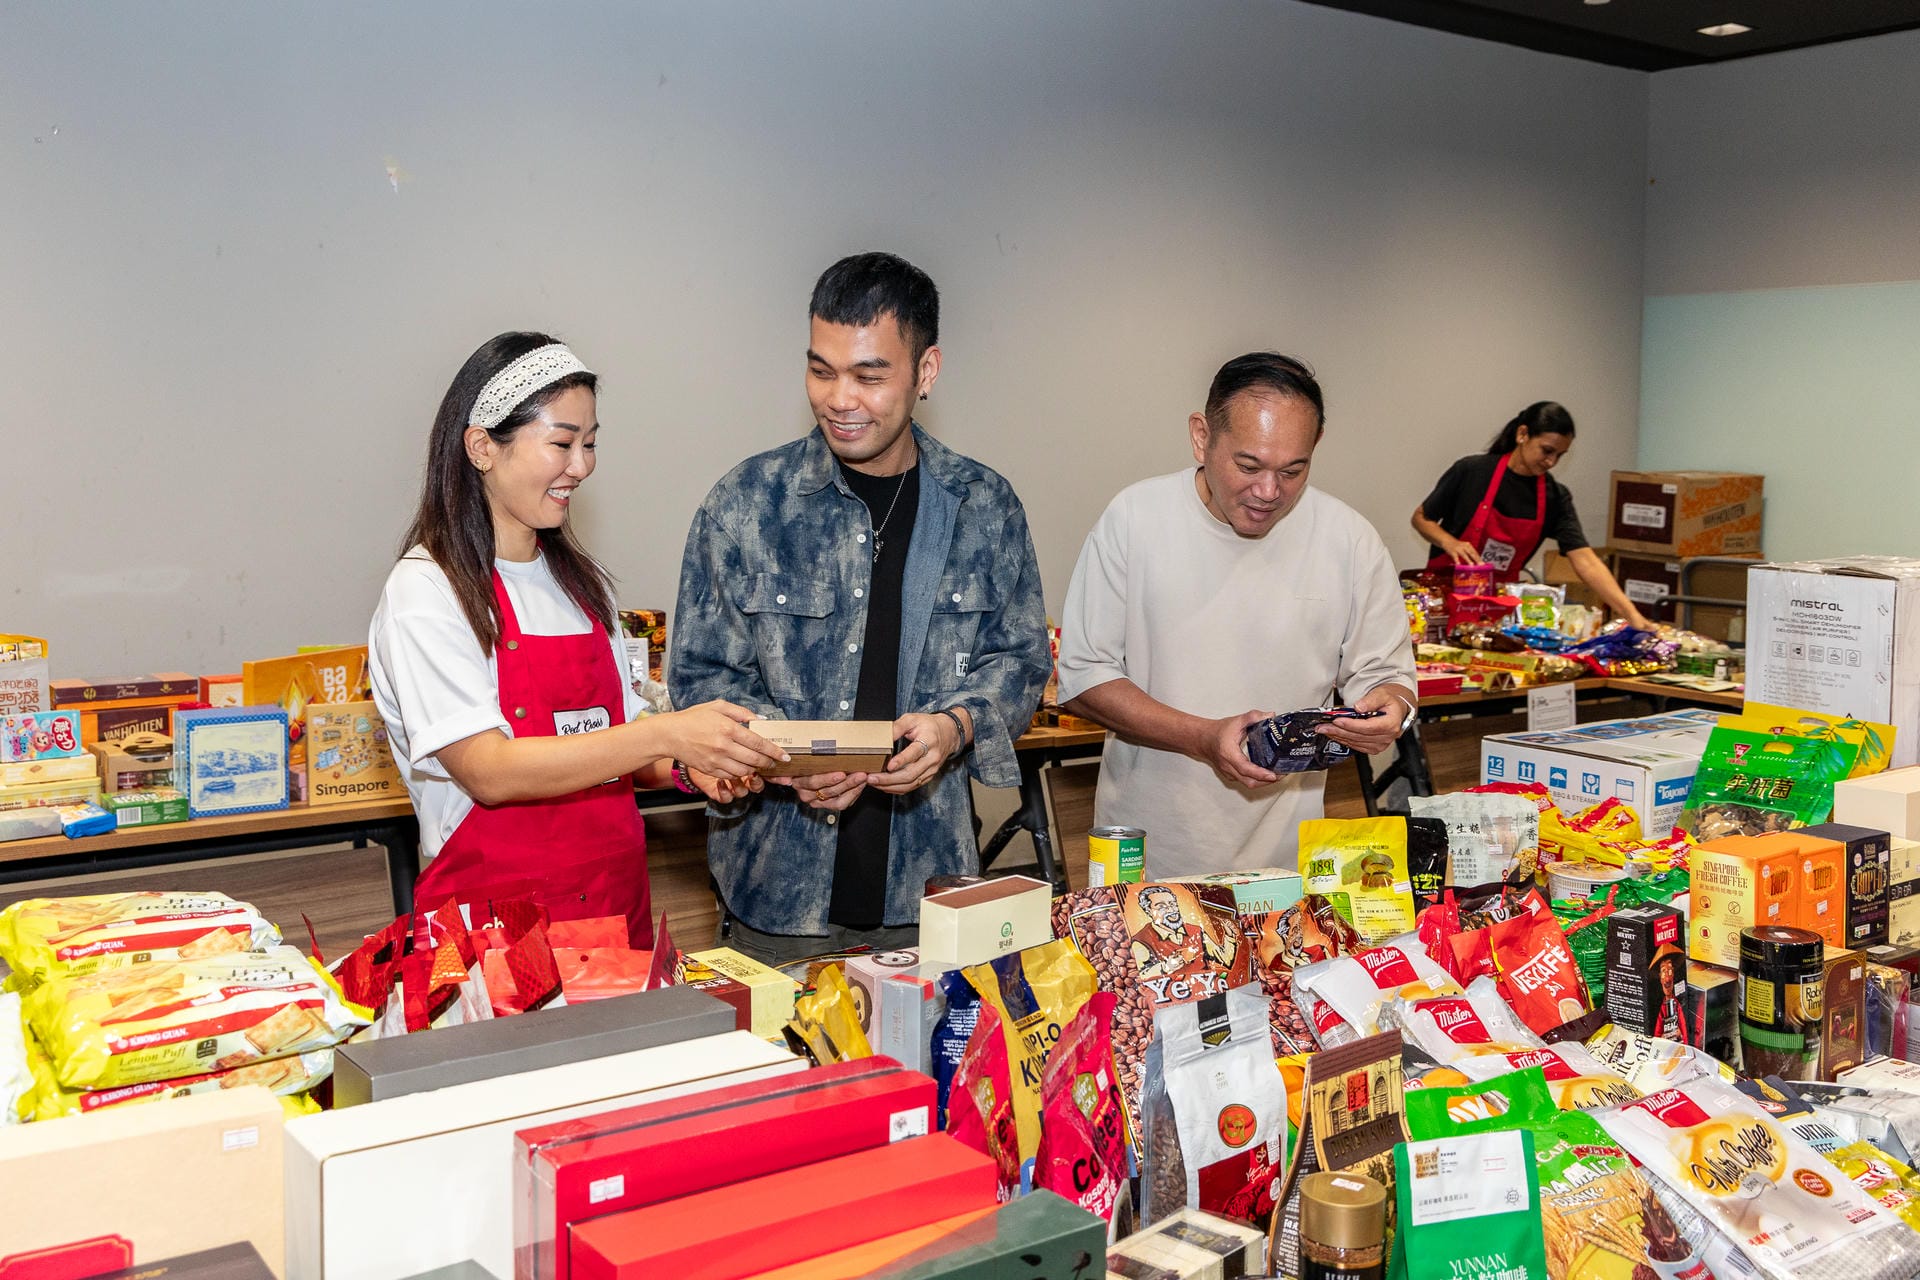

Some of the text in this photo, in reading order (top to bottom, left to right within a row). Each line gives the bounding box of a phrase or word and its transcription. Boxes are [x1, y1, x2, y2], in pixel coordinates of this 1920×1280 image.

[1790, 599, 1844, 612] mistral
[104, 728, 122, 742] VAN
[121, 717, 164, 741] HOUTEN
[562, 722, 581, 735] Red
[1489, 758, 1503, 769] 12
[315, 780, 390, 796] Singapore
[1726, 773, 1796, 800] 牛肝菌
[1312, 859, 1335, 874] 1891
[1703, 861, 1741, 876] SINGAPORE
[1696, 869, 1748, 889] FRESH COFFEE
[1238, 899, 1274, 913] RIAN
[138, 954, 149, 962] 12
[1360, 948, 1401, 969] Mister
[1436, 1005, 1473, 1028] Mister
[129, 1032, 162, 1047] KHONG
[203, 1039, 213, 1048] 12
[119, 1045, 189, 1067] Lemon Puff
[101, 1087, 133, 1103] KHONG
[1329, 1118, 1395, 1160] DURIAN KING
[1691, 1123, 1773, 1192] White Coffee
[1562, 1159, 1616, 1188] MALT
[1448, 1252, 1508, 1277] YUNNAN
